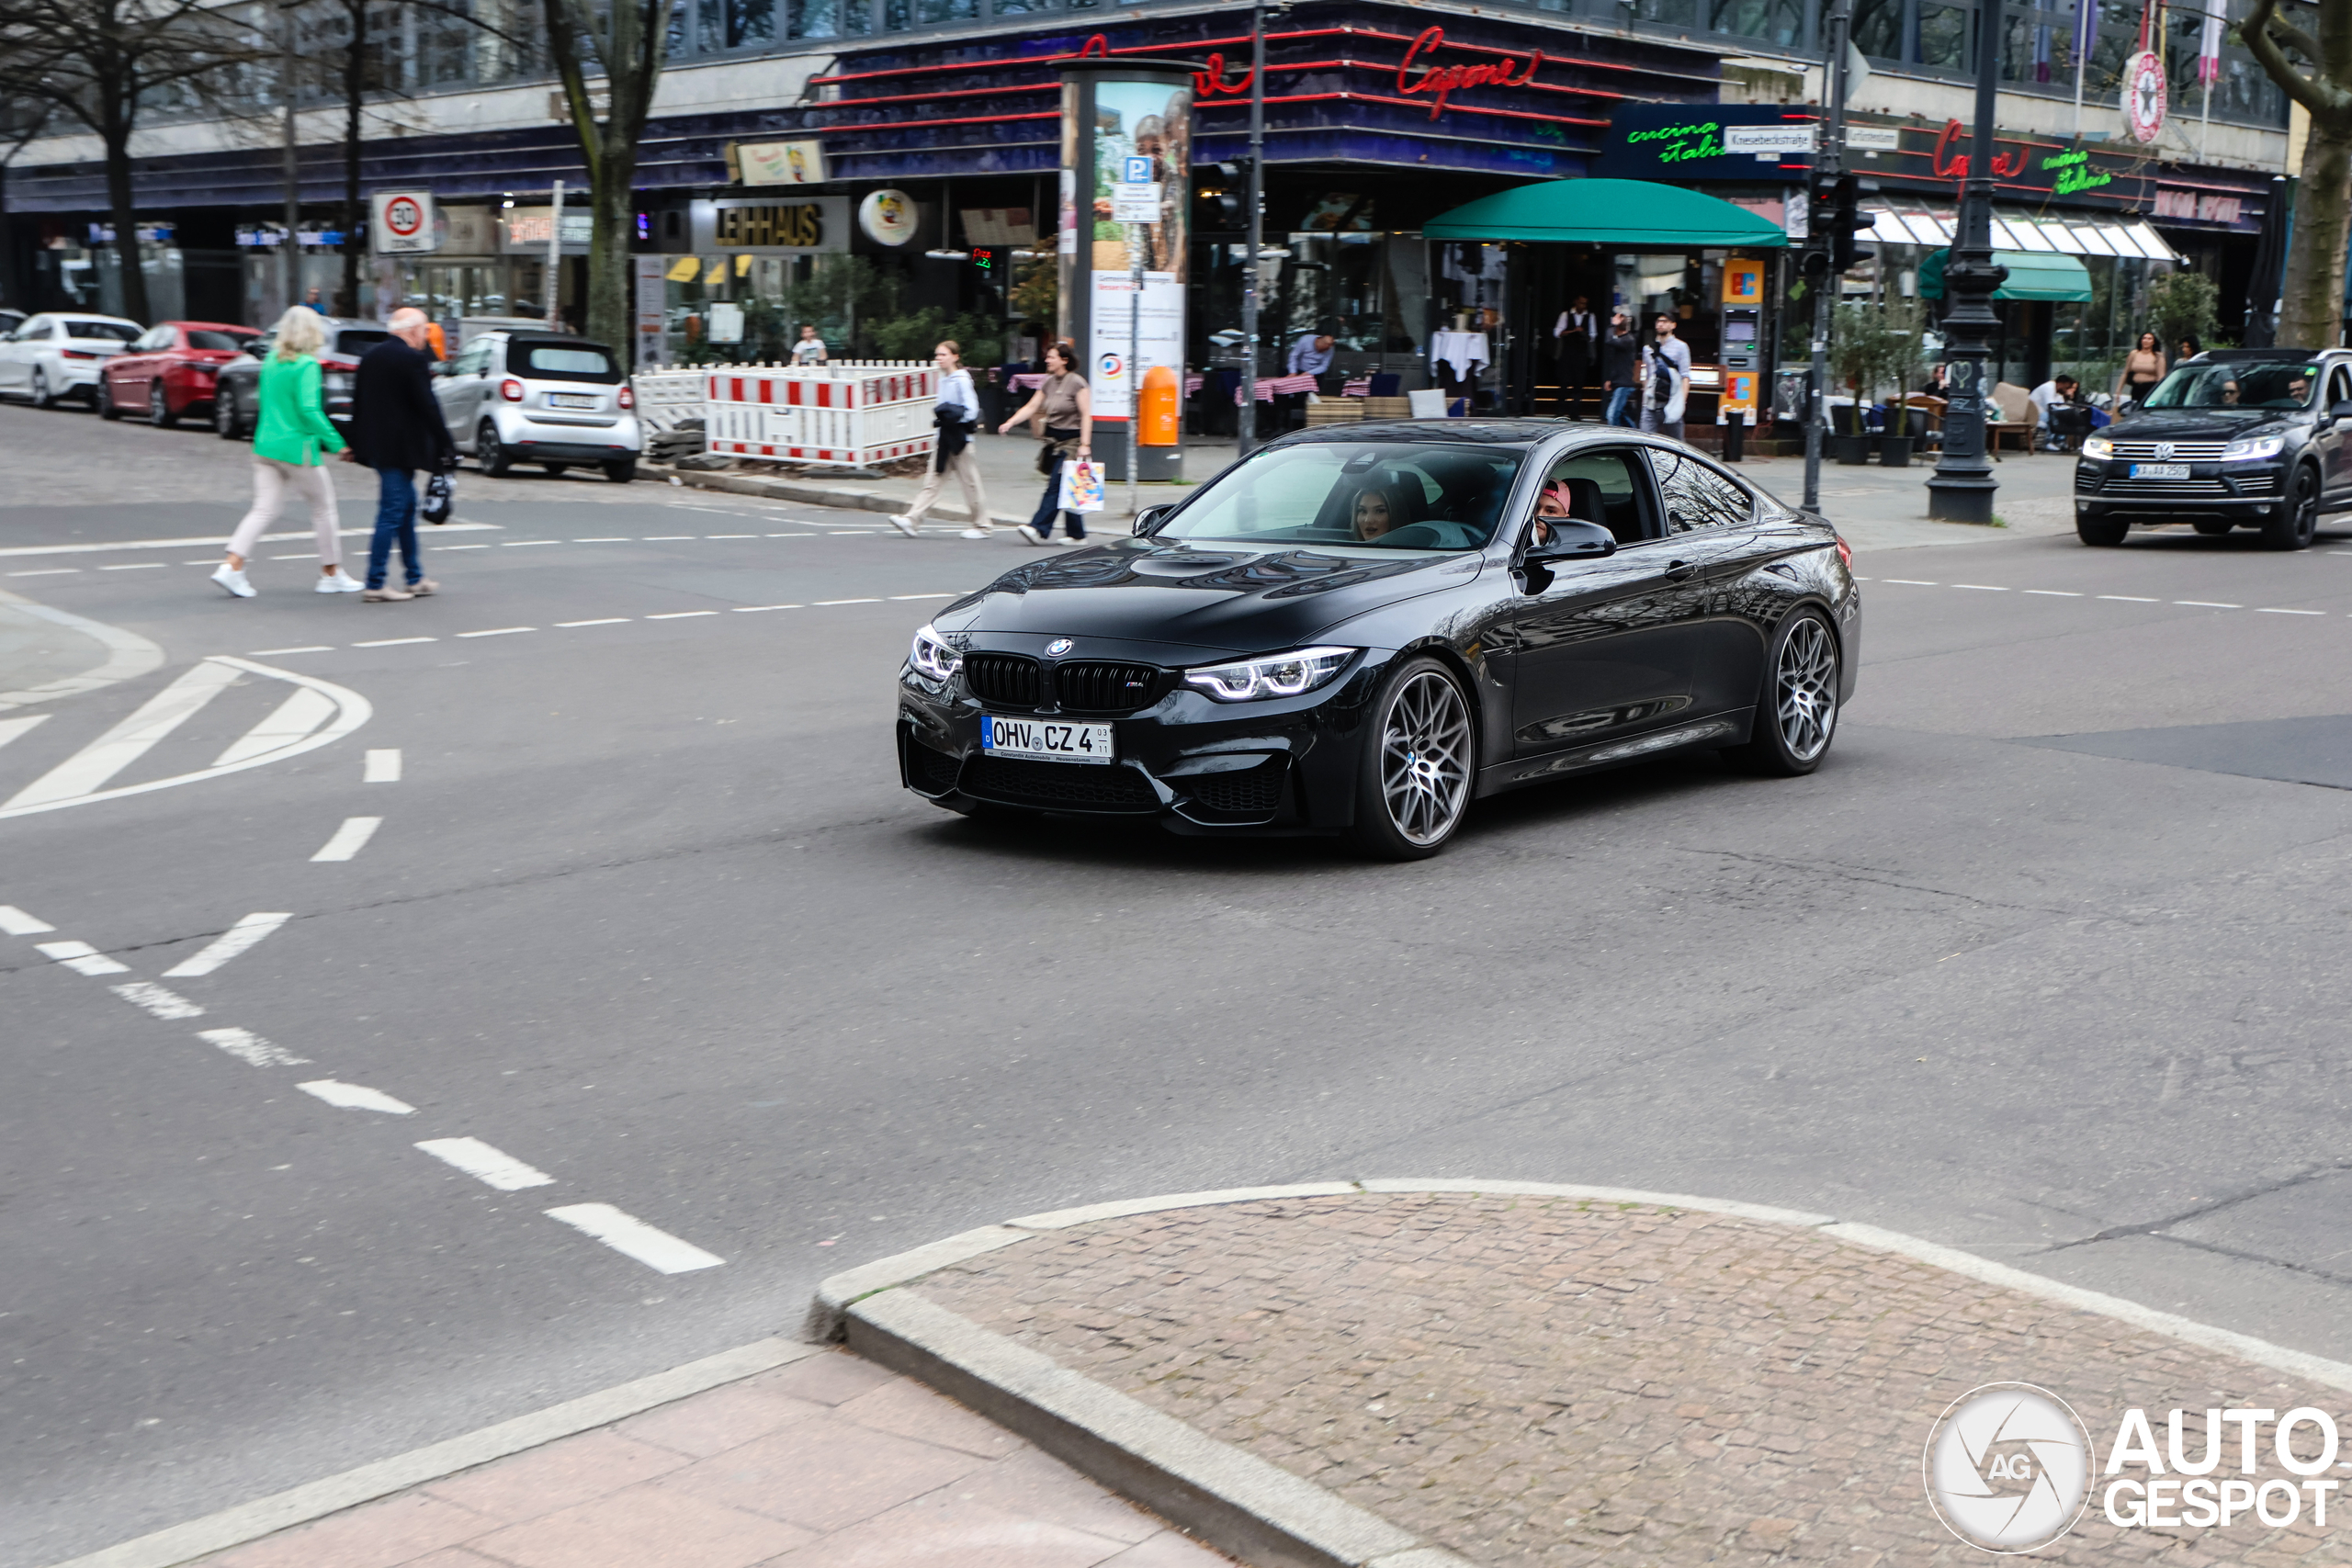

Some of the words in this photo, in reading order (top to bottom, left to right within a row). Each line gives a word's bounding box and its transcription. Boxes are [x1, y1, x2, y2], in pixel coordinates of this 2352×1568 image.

[1396, 26, 1544, 121] Capone
[1627, 121, 1719, 143] cucina
[1731, 133, 1808, 148] Knesebeckstraße
[1128, 159, 1147, 181] P
[1933, 118, 2030, 202] Capne
[391, 208, 416, 225] 30
[716, 205, 822, 246] LEIHHAUS
[1731, 273, 1755, 295] EC
[1726, 378, 1750, 399] EC
[993, 721, 1032, 748] OHV
[1046, 726, 1074, 751] CZ
[1079, 728, 1092, 752] 4
[1099, 745, 1107, 753] 11
